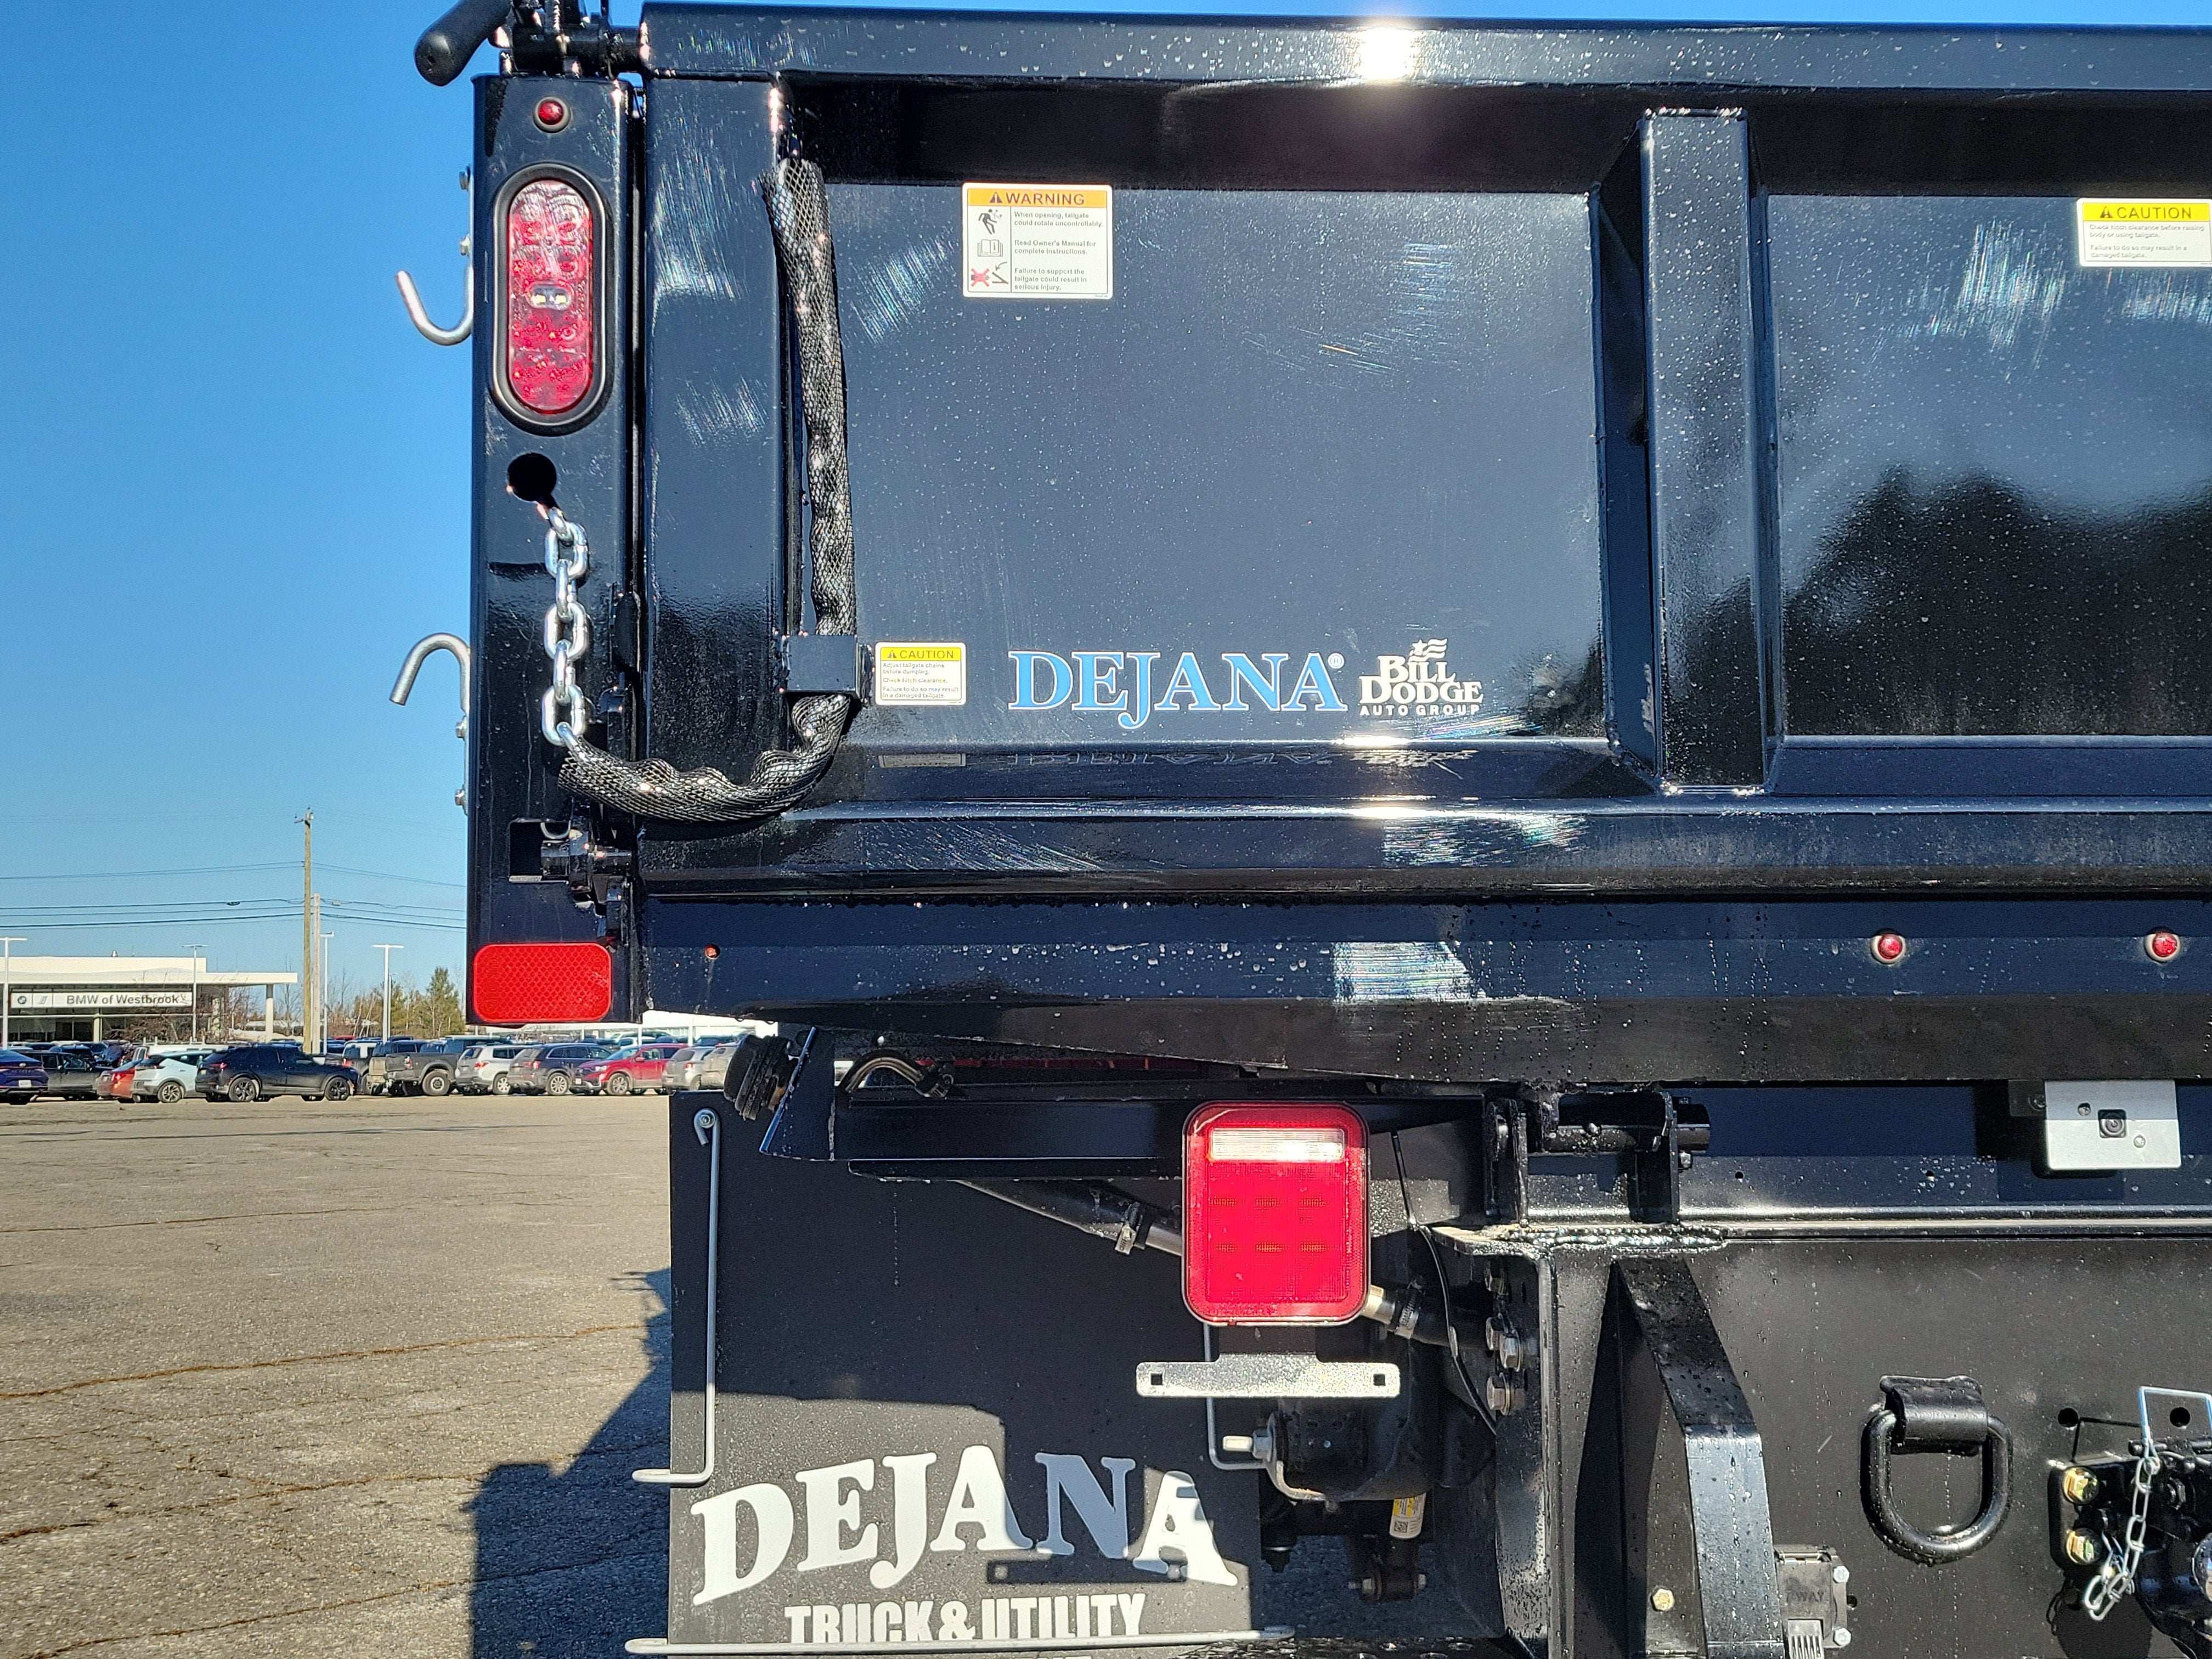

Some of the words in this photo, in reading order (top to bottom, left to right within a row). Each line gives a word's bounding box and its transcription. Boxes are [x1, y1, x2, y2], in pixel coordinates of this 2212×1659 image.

[1006, 193, 1085, 205] WARNING
[2117, 207, 2191, 219] CAUTION
[900, 650, 953, 658] CAUTION
[1378, 655, 1455, 683] BILL
[1359, 675, 1484, 704] DODGE
[1359, 704, 1409, 716] AUTO
[1416, 704, 1480, 716] GROUP
[67, 995, 99, 1004] BMW
[102, 995, 114, 1004] of
[116, 995, 178, 1004] Westbrook
[690, 1444, 1238, 1606] DEJANA
